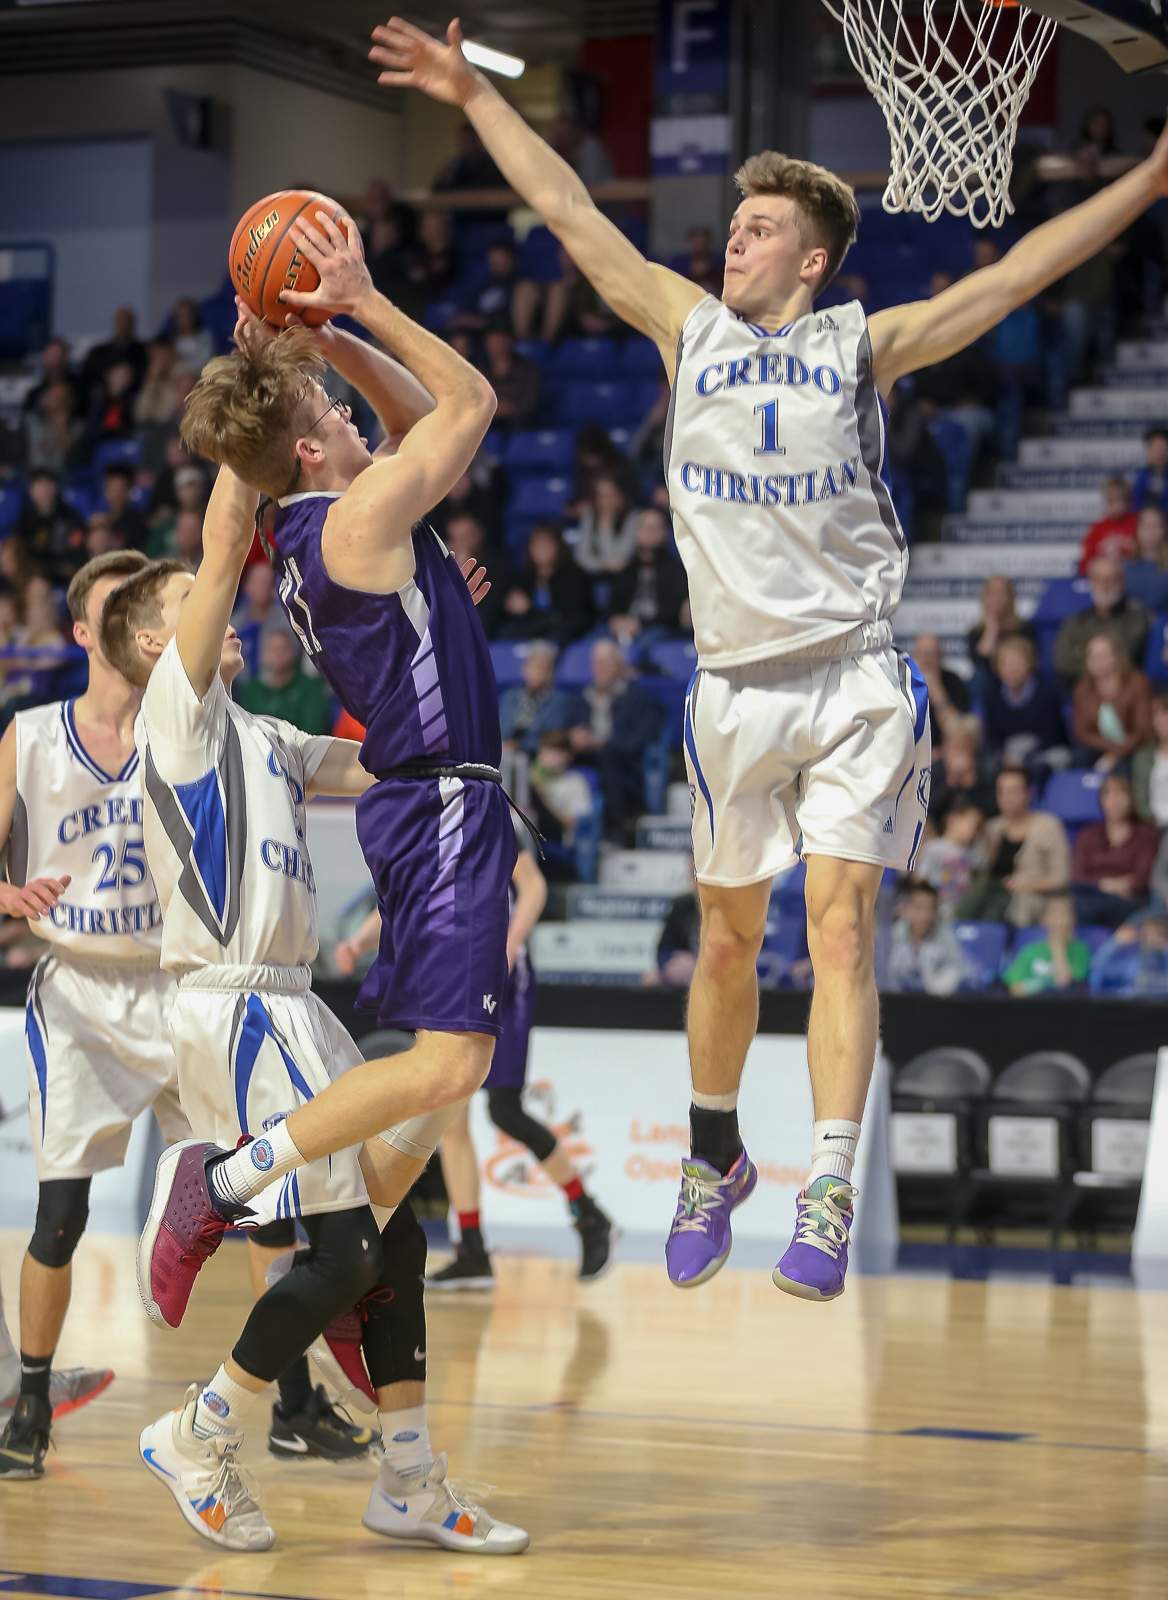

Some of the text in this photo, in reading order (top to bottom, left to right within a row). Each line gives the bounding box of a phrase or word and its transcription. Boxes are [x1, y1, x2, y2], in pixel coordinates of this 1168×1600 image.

[671, 0, 719, 74] F
[695, 352, 842, 397] CREDO
[753, 397, 786, 456] 1
[680, 456, 859, 506] CHRISTIAN
[92, 839, 148, 893] 25
[49, 901, 163, 936] CHRISTI
